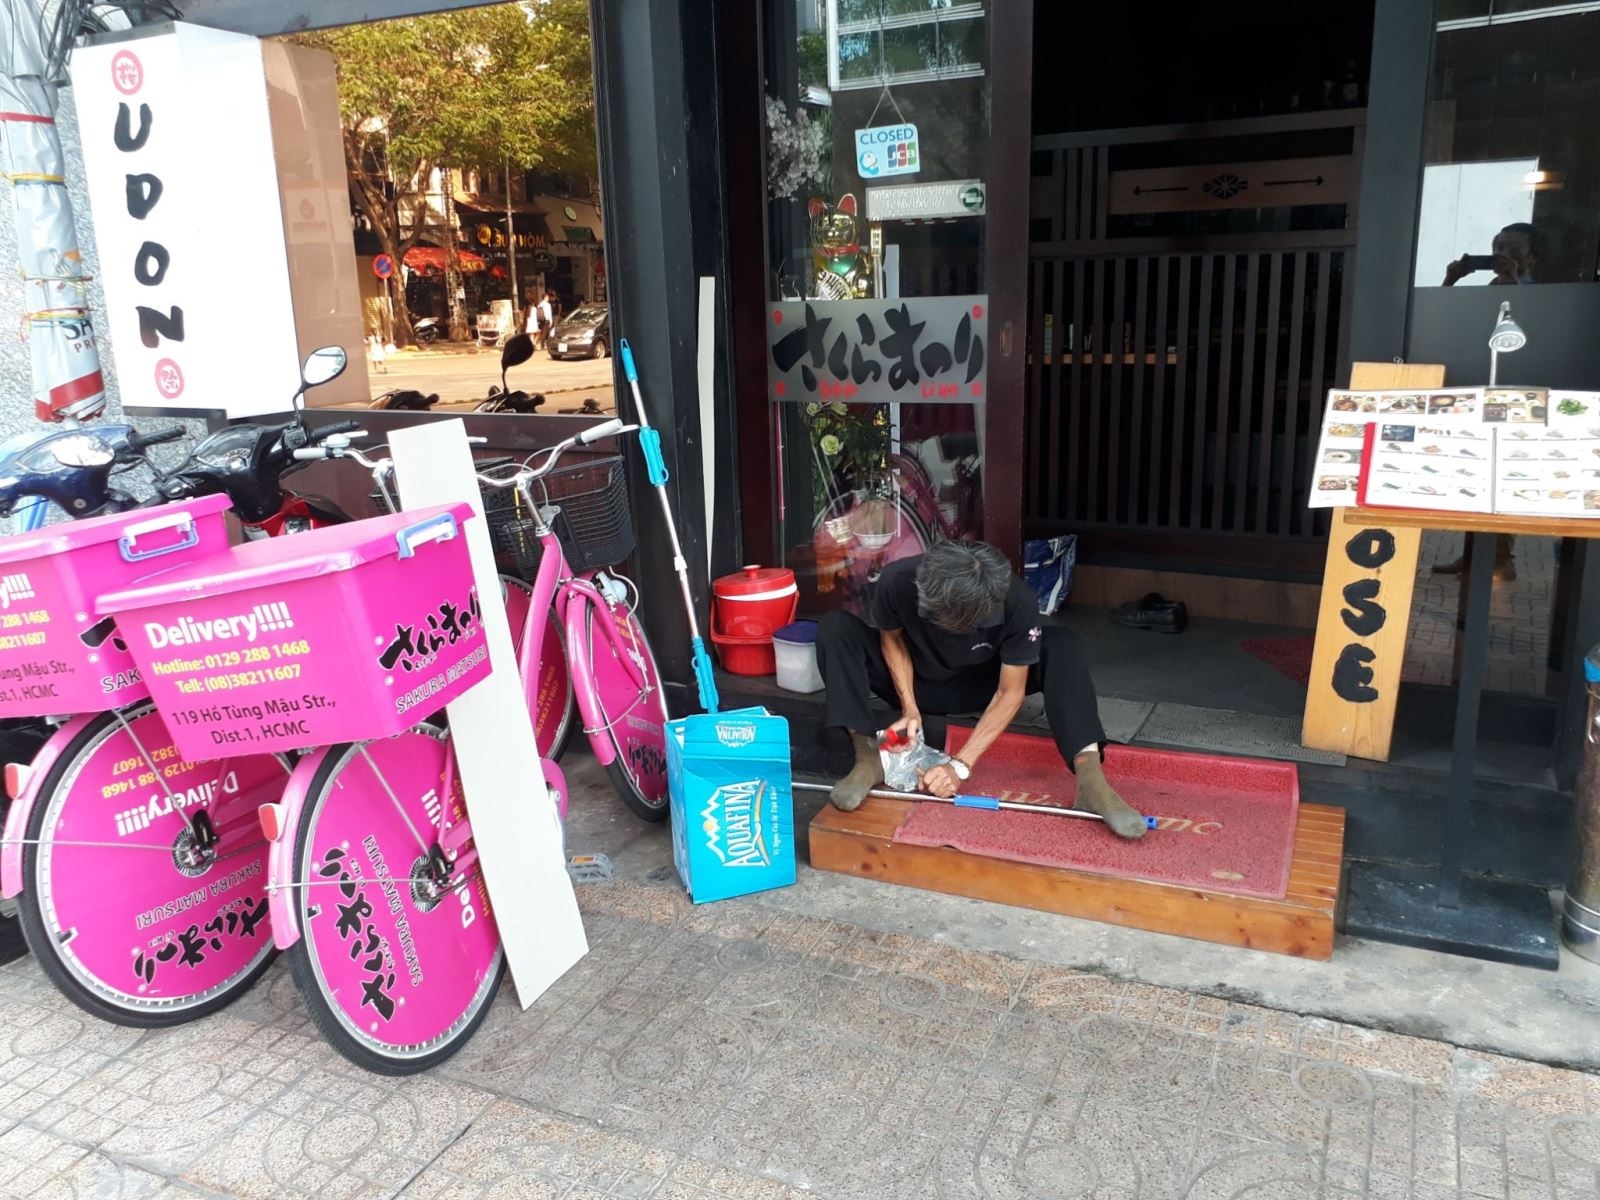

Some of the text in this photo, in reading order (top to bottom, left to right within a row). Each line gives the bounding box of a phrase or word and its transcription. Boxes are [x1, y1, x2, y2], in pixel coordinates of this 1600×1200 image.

[859, 127, 914, 146] CLOSED
[113, 102, 184, 349] UDON
[772, 303, 983, 393] さくらまつり
[22, 609, 51, 625] 1468
[144, 601, 294, 649] Delivery!!!!
[1331, 528, 1396, 703] OSE
[152, 639, 311, 676] Hotline: 0129 288 1468
[21, 683, 59, 700] HCMC
[175, 663, 301, 694] Tell: (08)38211607
[396, 675, 447, 714] SAKURA
[447, 644, 488, 685] MATSURI
[172, 710, 198, 726] 119
[264, 697, 301, 717] Mậu
[260, 719, 311, 739] HCMC
[715, 724, 756, 742] AQUAFINA
[101, 762, 195, 799] 0129 88 1468
[723, 779, 767, 867] AQUAFINA
[210, 860, 262, 892] SAKURA
[362, 834, 401, 914] MATSURI
[136, 891, 207, 930] MATSURI
[133, 896, 269, 985] さくらまつり
[319, 847, 396, 1022] さくらまつり
[396, 914, 424, 987] SAKURA
